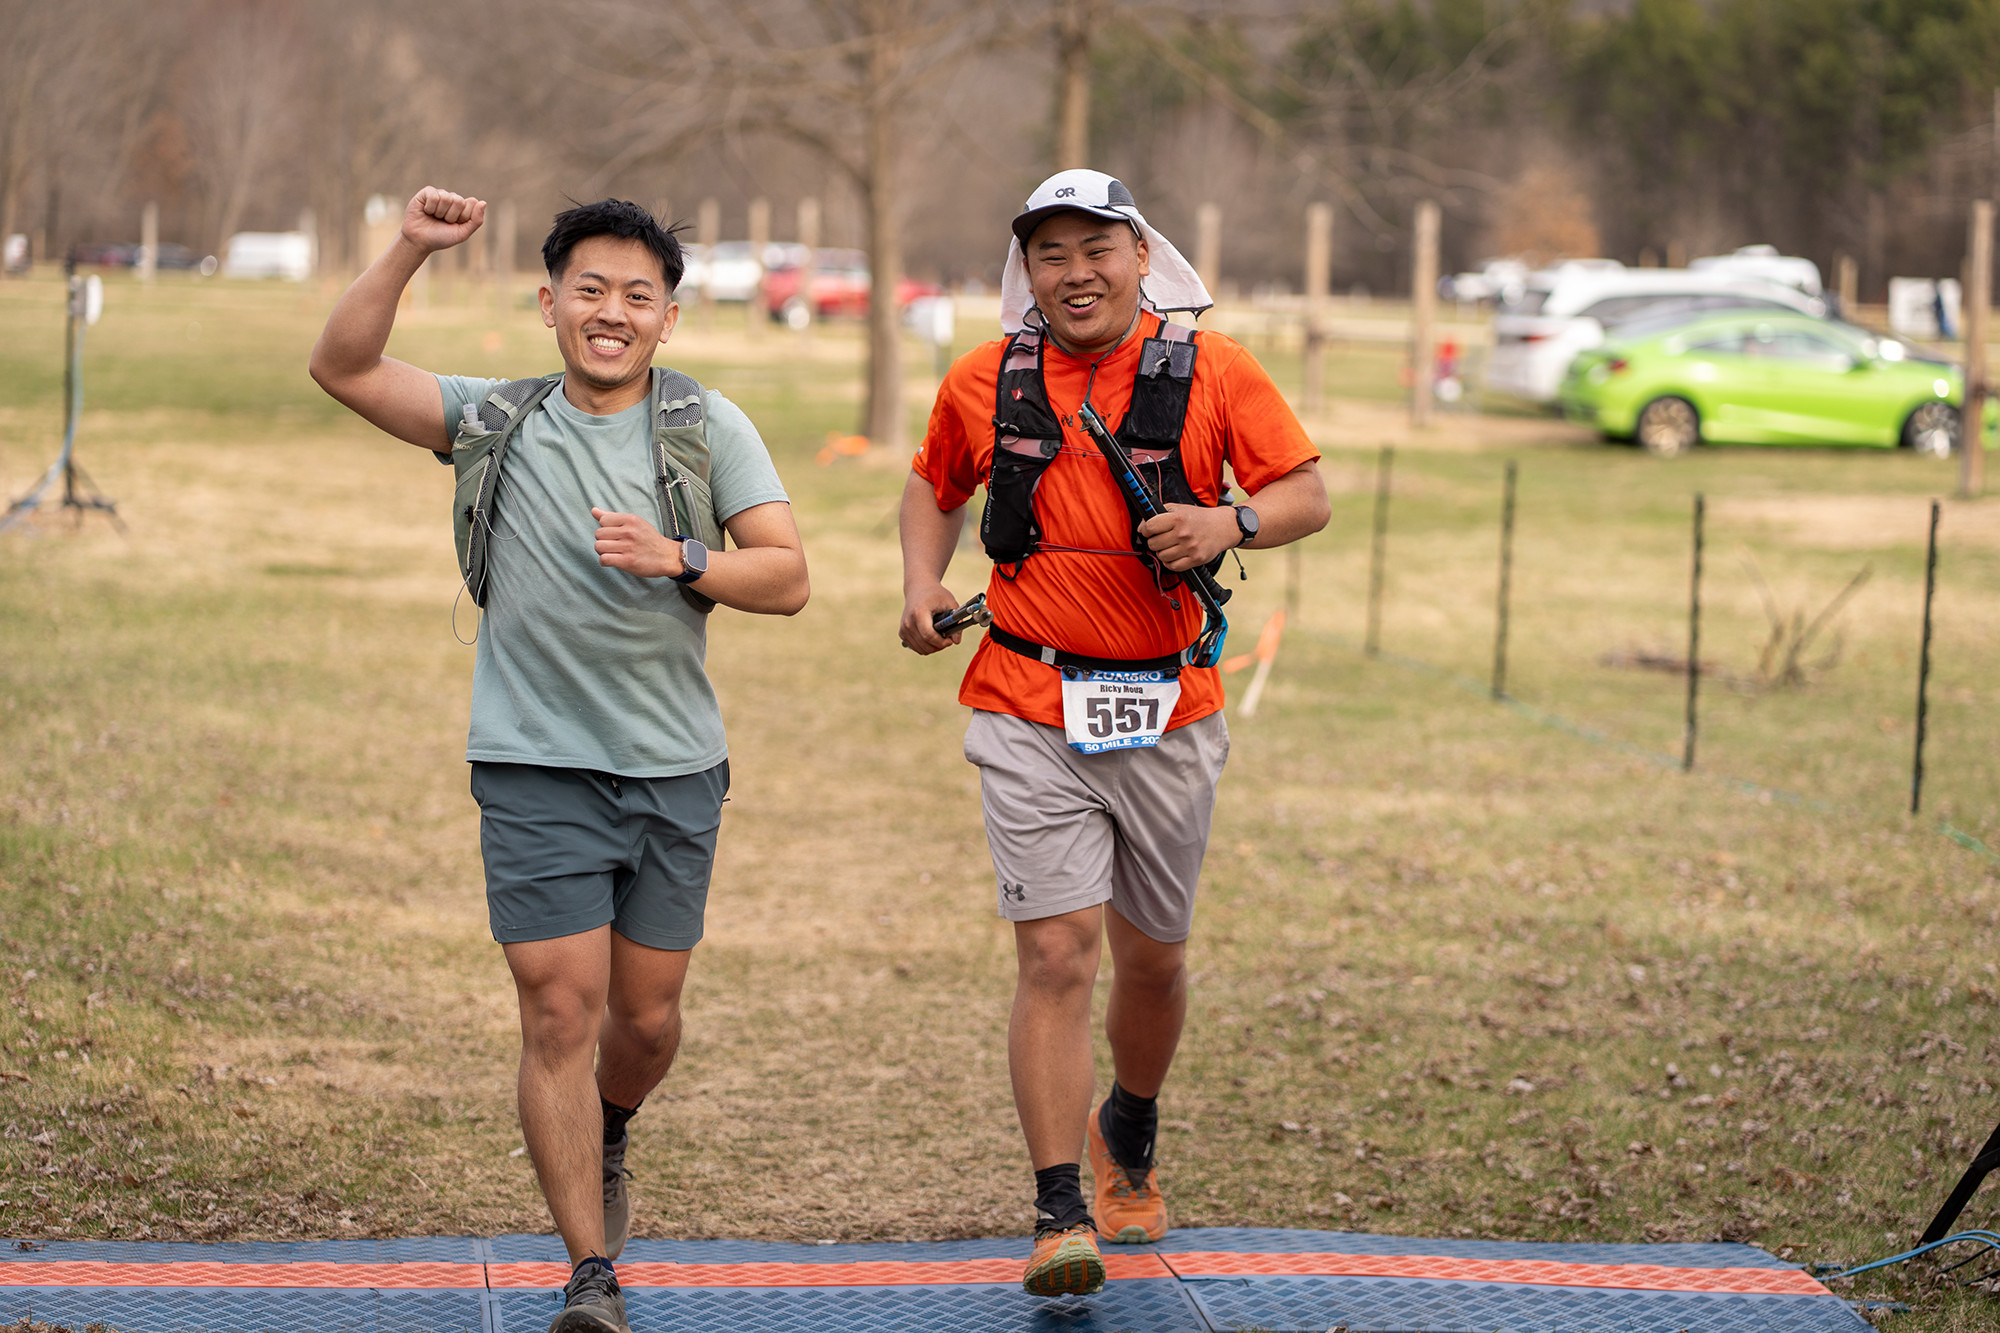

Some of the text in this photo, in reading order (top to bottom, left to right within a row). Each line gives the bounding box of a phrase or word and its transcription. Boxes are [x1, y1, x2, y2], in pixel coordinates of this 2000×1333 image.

[1055, 187, 1076, 198] OR
[1100, 684, 1144, 694] Ricky Moua
[1086, 697, 1159, 738] 557
[1084, 743, 1100, 752] 50
[1101, 738, 1133, 750] MILE
